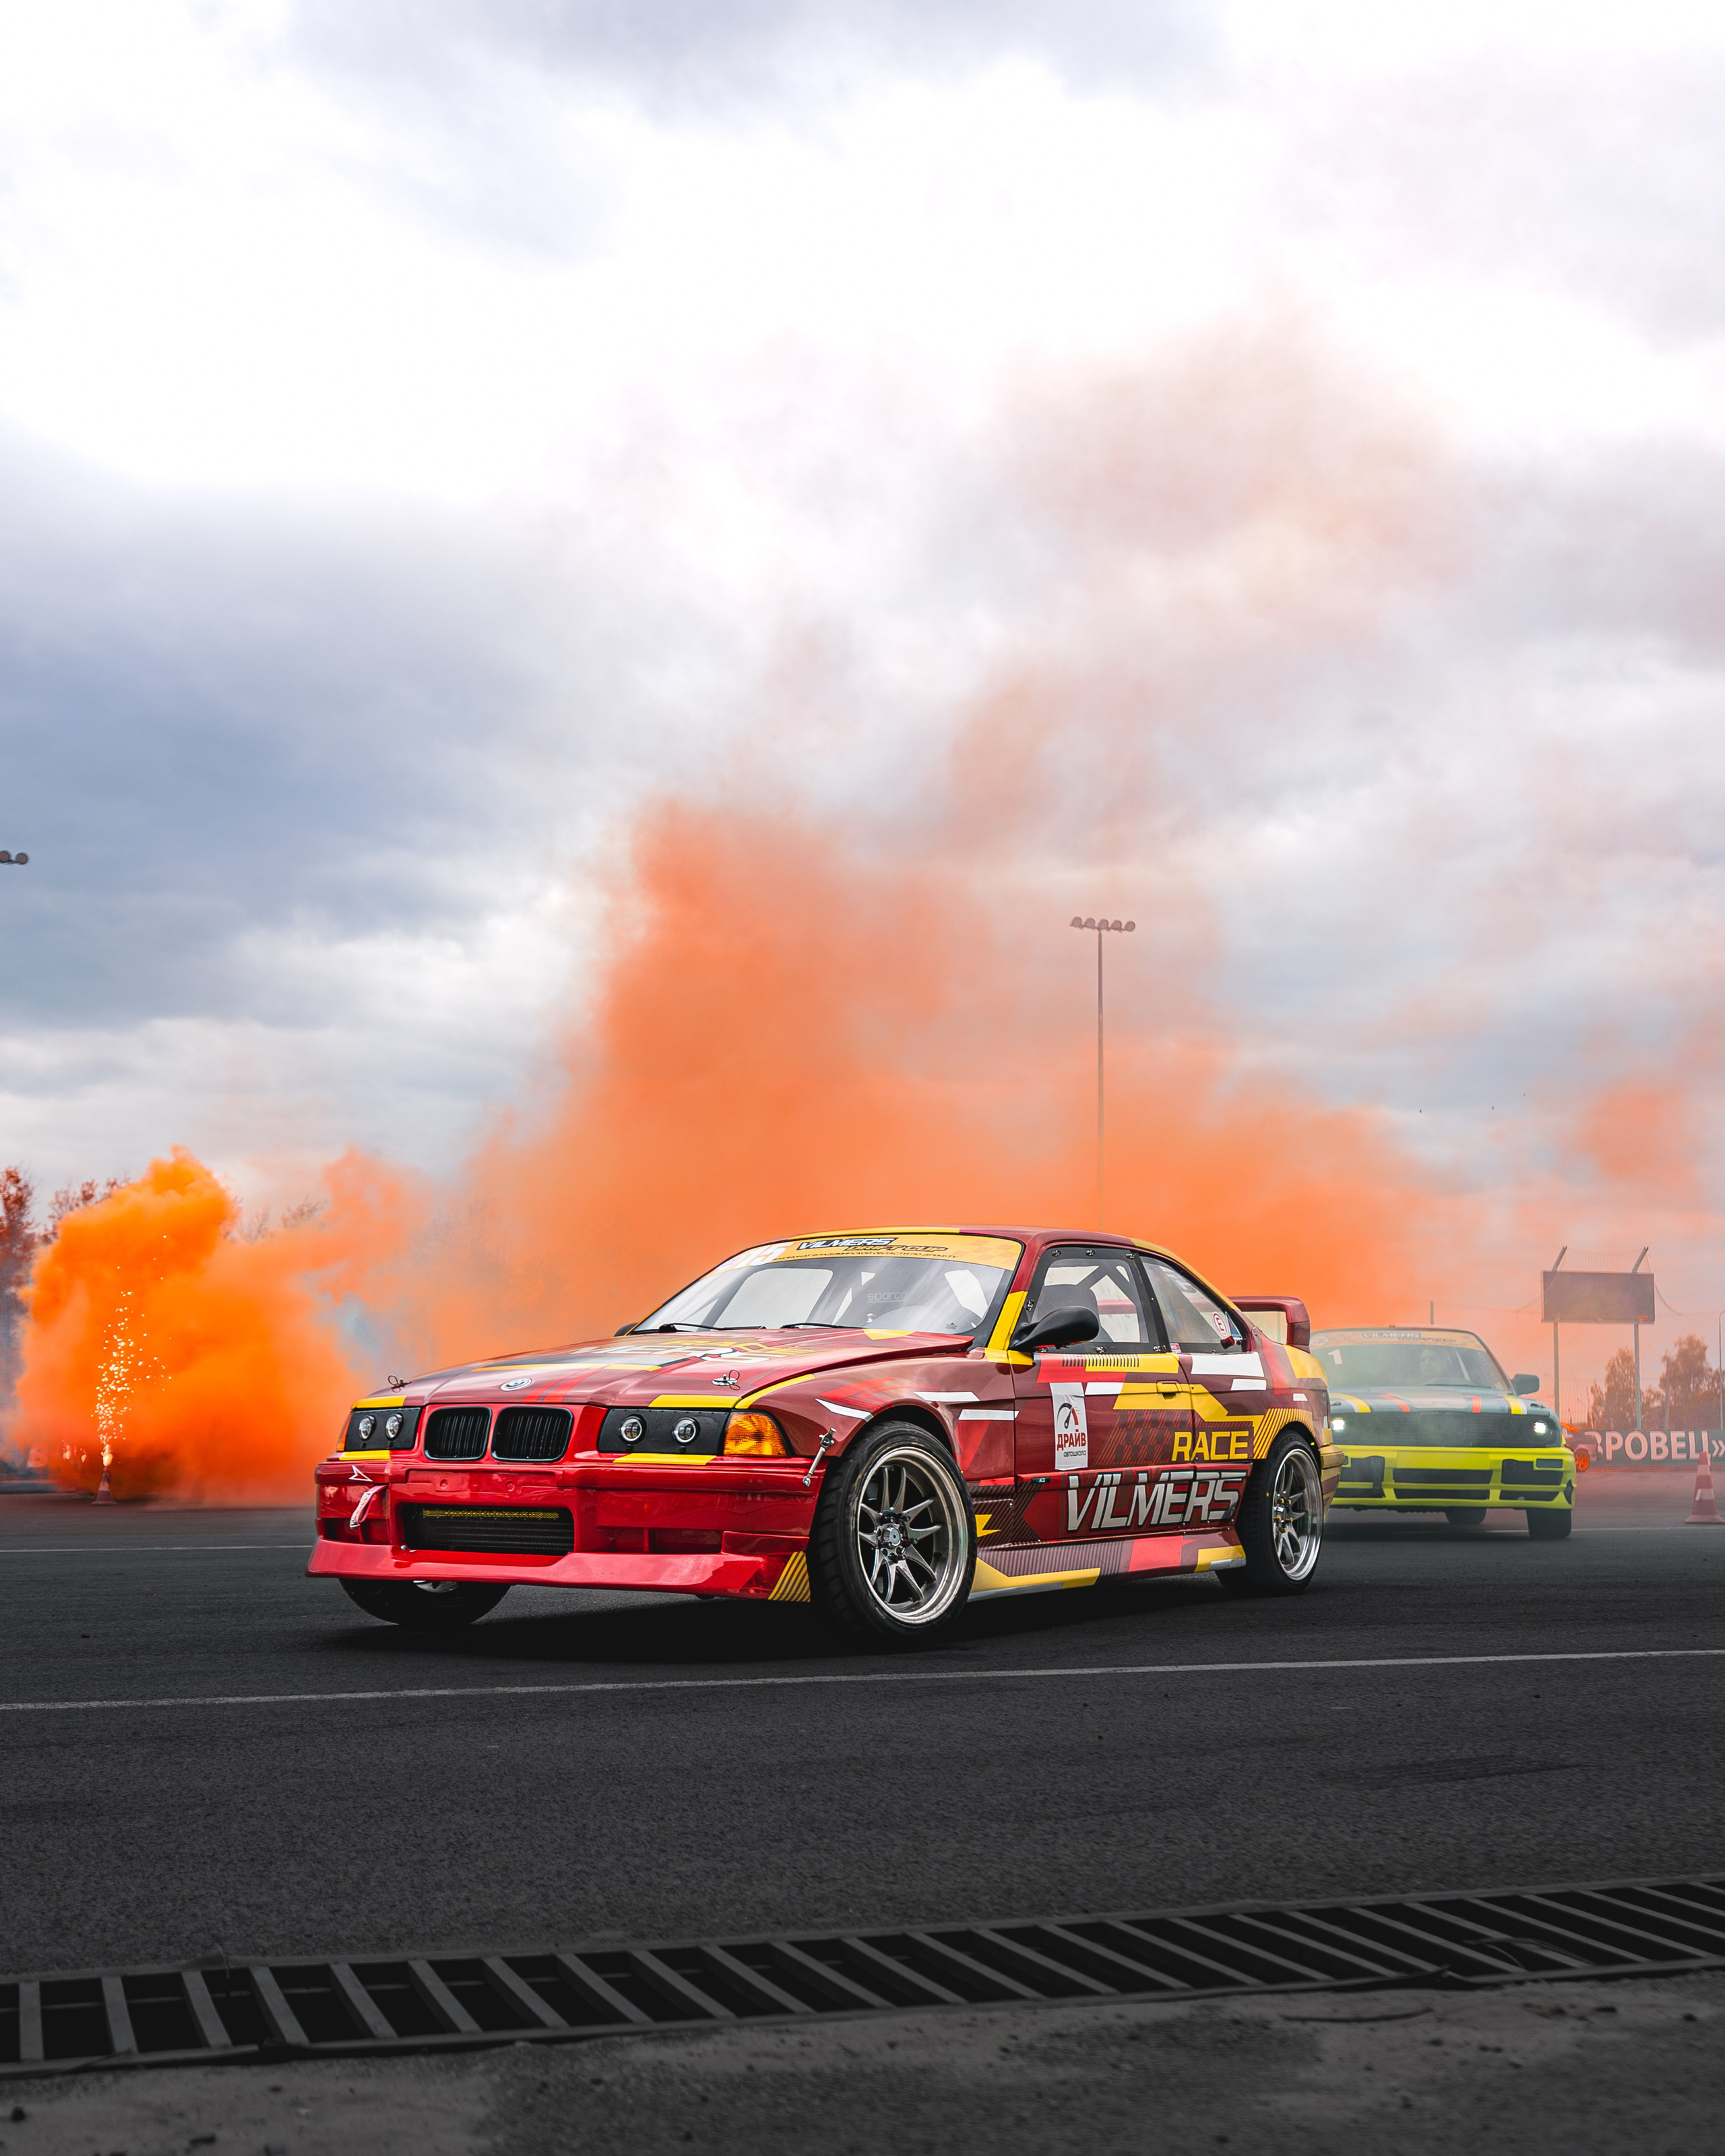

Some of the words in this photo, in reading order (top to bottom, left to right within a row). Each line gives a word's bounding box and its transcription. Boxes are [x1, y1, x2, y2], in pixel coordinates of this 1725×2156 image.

[798, 1238, 896, 1250] VILMERS
[867, 1292, 907, 1304] sparco
[663, 1340, 814, 1354] RACE
[1328, 1349, 1342, 1364] 1
[1057, 1429, 1086, 1451] ДРАЙВ
[1172, 1431, 1249, 1461] RACE
[1067, 1471, 1247, 1531] VILMERS
